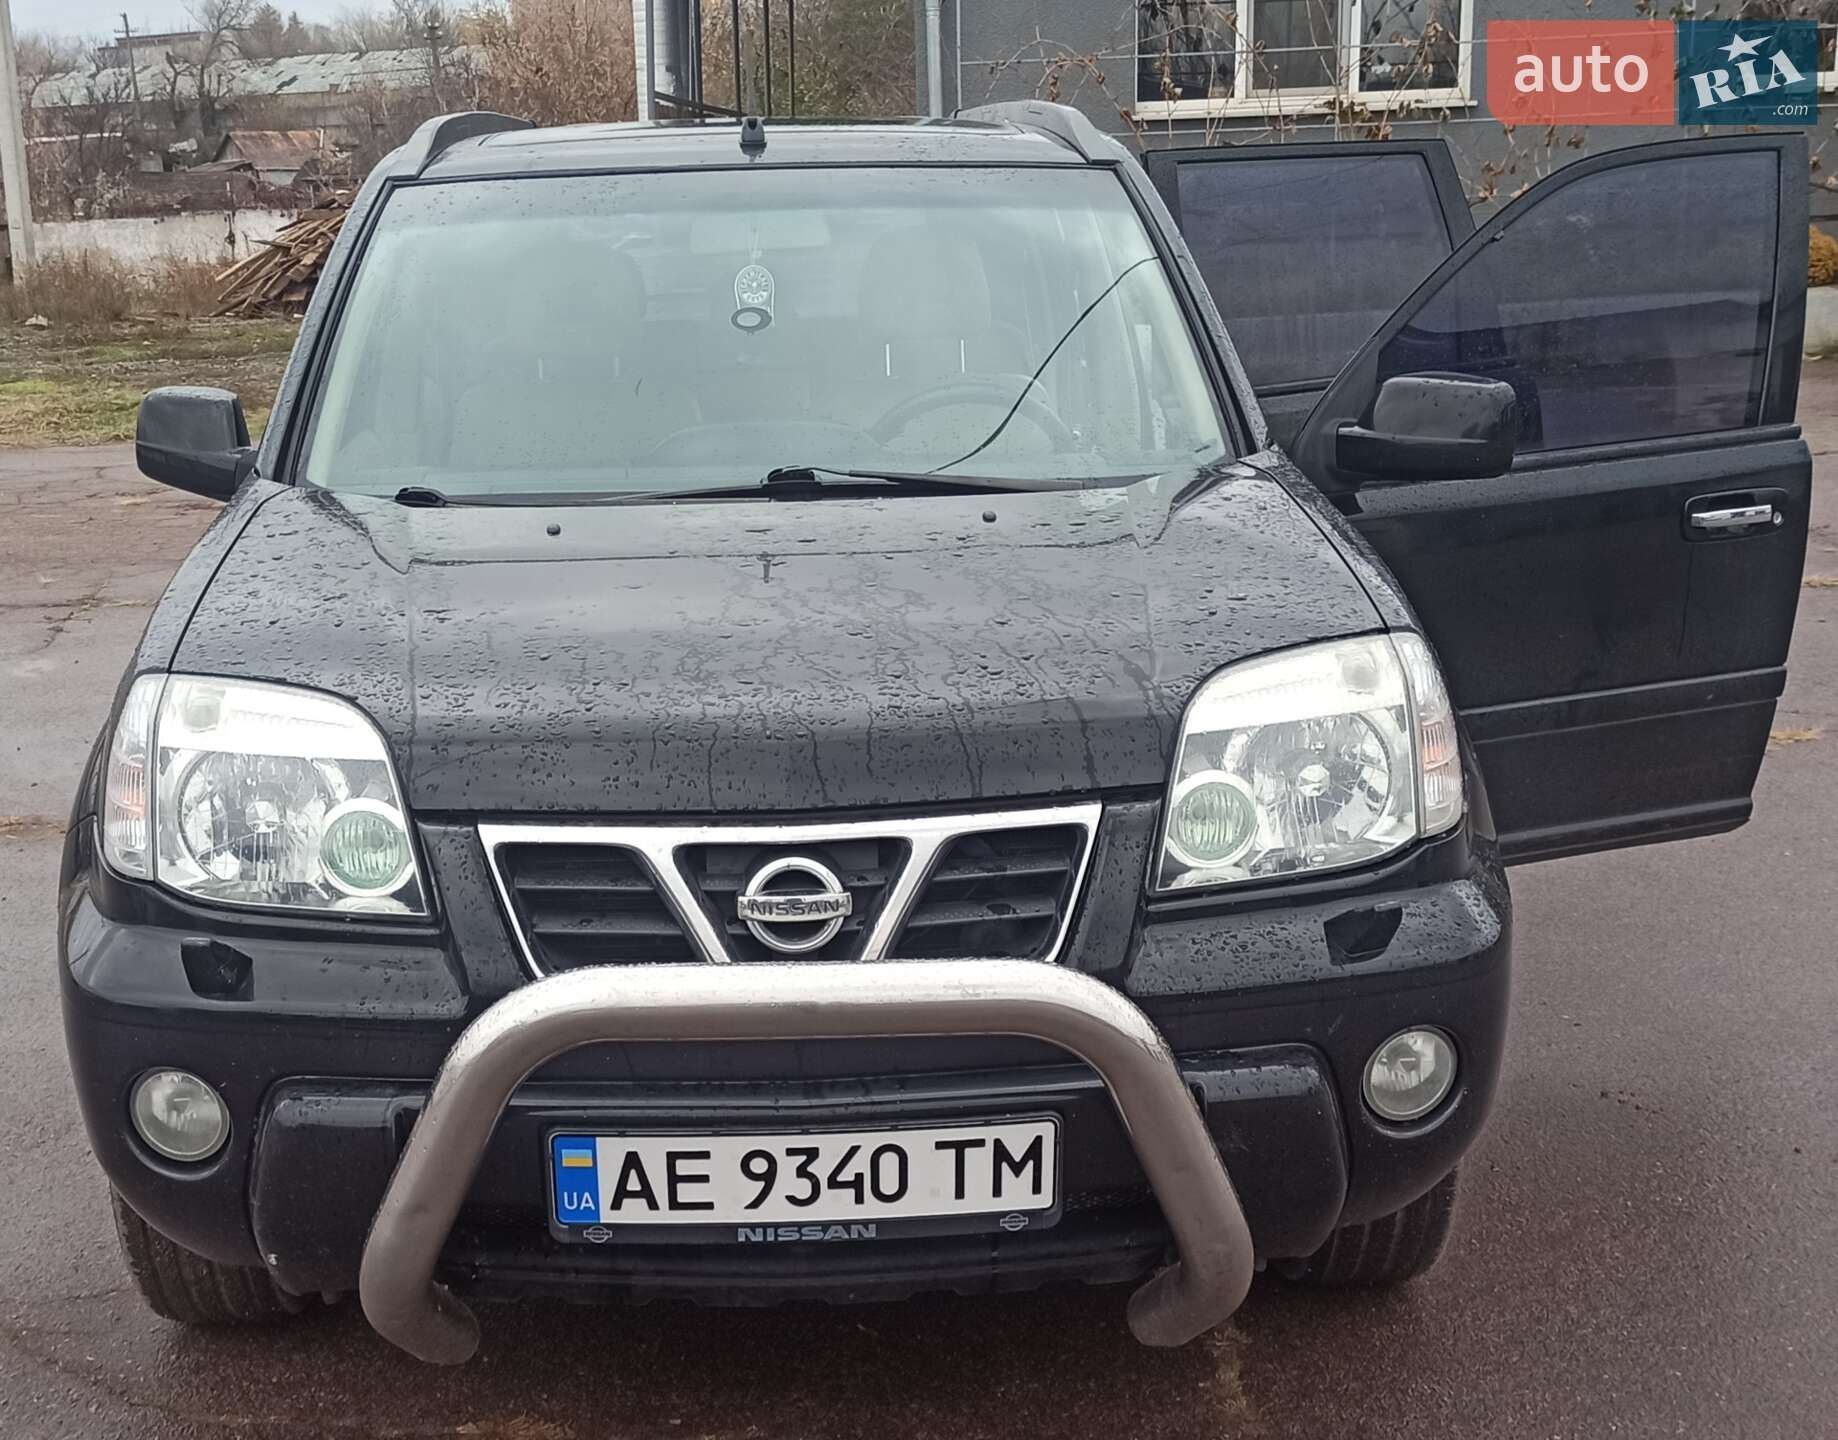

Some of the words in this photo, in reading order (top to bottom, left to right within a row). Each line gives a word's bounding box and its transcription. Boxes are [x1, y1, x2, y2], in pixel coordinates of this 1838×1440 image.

[750, 899, 840, 916] NISSAN
[610, 1150, 715, 1211] AE
[739, 1143, 909, 1209] 9340
[935, 1135, 1043, 1199] TM
[563, 1191, 596, 1211] UA
[737, 1223, 877, 1243] NISSAN
